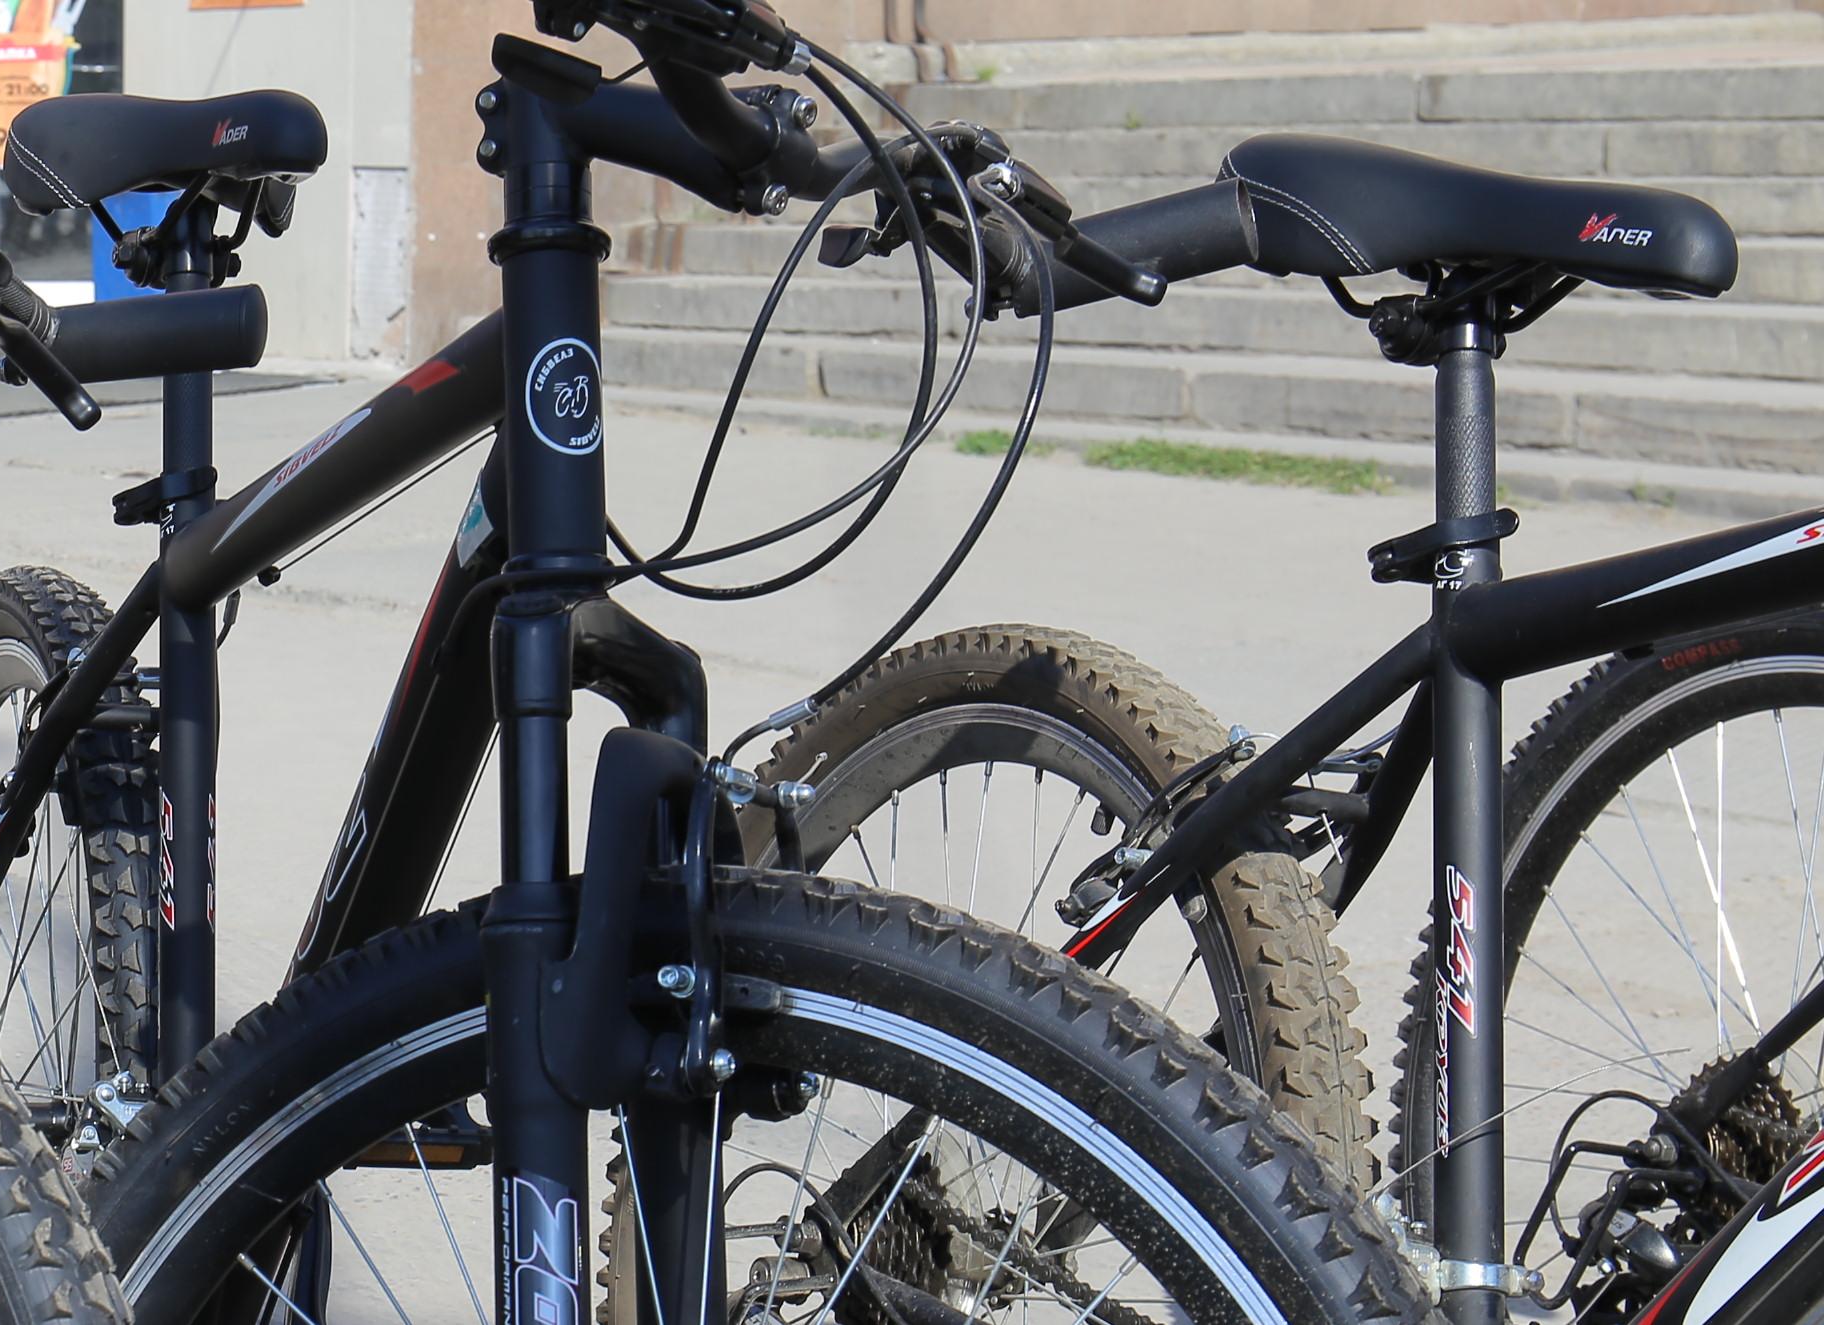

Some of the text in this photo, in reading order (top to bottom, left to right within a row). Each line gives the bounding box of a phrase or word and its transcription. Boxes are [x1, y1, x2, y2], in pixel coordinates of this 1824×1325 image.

[212, 117, 248, 147] VADER
[1578, 211, 1653, 247] VADER
[534, 347, 574, 392] СИБВЕЛЗ
[1449, 580, 1462, 590] 17
[1446, 865, 1477, 1038] 541
